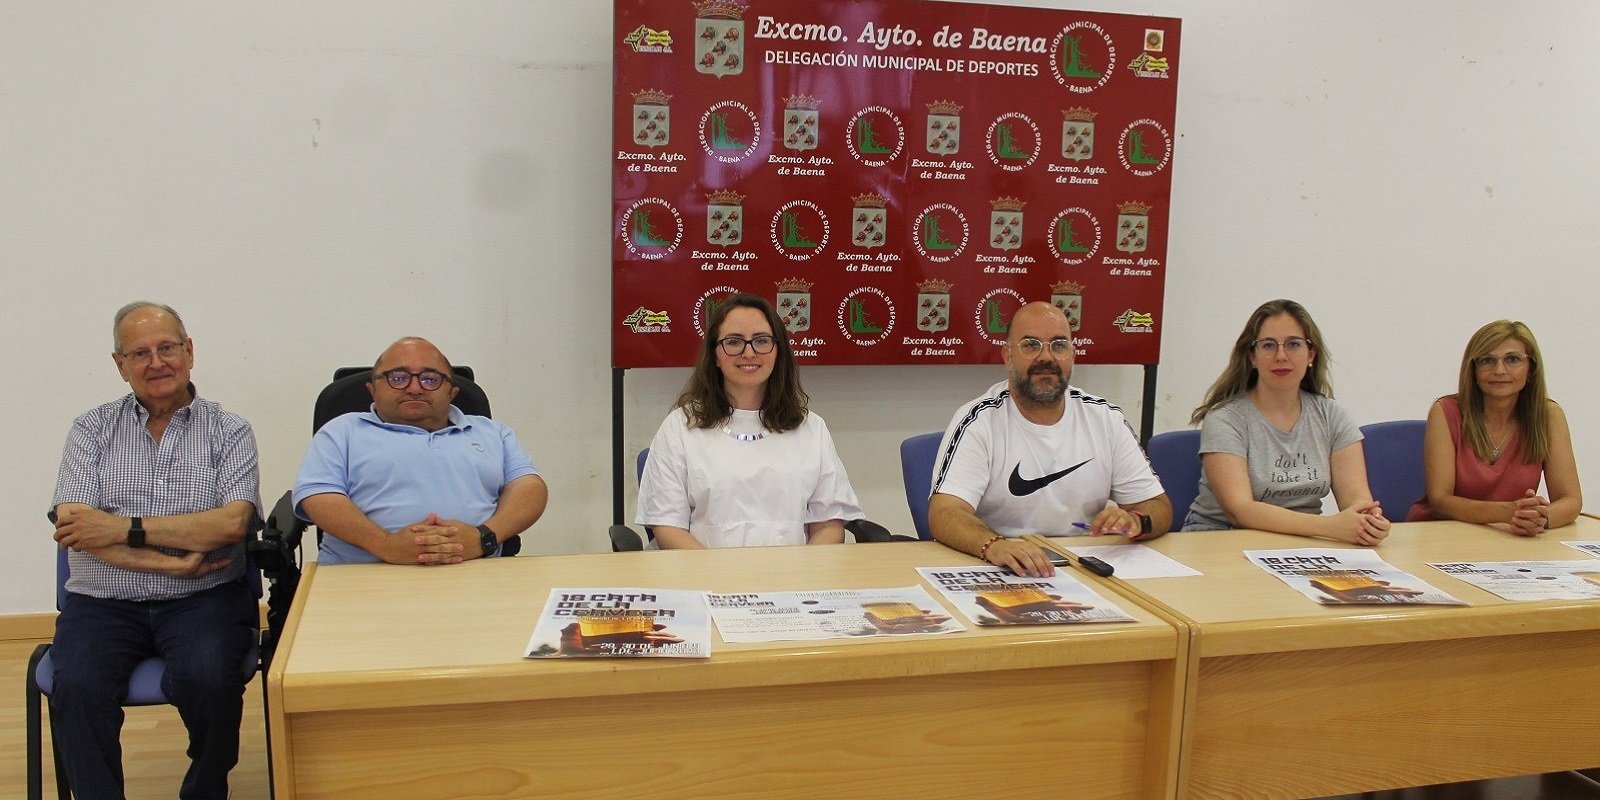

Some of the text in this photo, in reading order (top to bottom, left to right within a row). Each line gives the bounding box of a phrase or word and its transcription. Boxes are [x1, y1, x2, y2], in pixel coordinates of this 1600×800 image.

[755, 16, 1047, 53] Excmo. Ayto. de Baena
[1049, 21, 1115, 86] DELEGACION MUNICIPAL DE DEPORTES
[765, 51, 1039, 77] DELEGACIÓN MUNICIPAL DE DEPORTES
[857, 106, 894, 117] MUNICIPAL
[996, 112, 1031, 124] MUNICIPAL
[699, 100, 760, 157] DELEGACION MUNICIPAL DE DEPORTES
[618, 151, 686, 162] Excmo. Ayto.
[768, 155, 833, 166] Excmo. Ayto.
[627, 163, 678, 173] de Baena
[912, 159, 973, 170] Excmo. Ayto.
[1048, 164, 1106, 175] Excmo. Ayto.
[777, 166, 826, 176] de Baena
[920, 171, 965, 180] de Baena
[1055, 175, 1099, 185] de Baena
[621, 197, 683, 253] DELEGACION MUNICIPAL DE DEPORTES
[770, 200, 830, 255] DELEGACION MUNICIPAL DE DEPORTES
[912, 203, 969, 257] DELEGACION MUNICIPAL DE DEPORTES
[732, 251, 757, 261] Ayto.
[876, 253, 900, 262] Ayto.
[1012, 255, 1035, 264] Ayto.
[701, 262, 750, 271] de Baena
[846, 263, 893, 272] de Baena
[1137, 258, 1159, 267] Ayto.
[984, 265, 1027, 274] de Baena
[1109, 267, 1152, 276] de Baena
[986, 288, 1020, 299] MUNICIPAL
[693, 296, 705, 336] ELEGACION
[837, 286, 896, 340] DELEGACION MUNICIPAL DE DEPORTES
[801, 338, 825, 346] Ayto.
[939, 337, 963, 346] Ayto.
[1072, 337, 1094, 346] Ayto.
[911, 347, 955, 356] de Baena
[1271, 467, 1319, 483] take it
[1261, 481, 1327, 502] personal
[561, 593, 657, 603] 18 CATA
